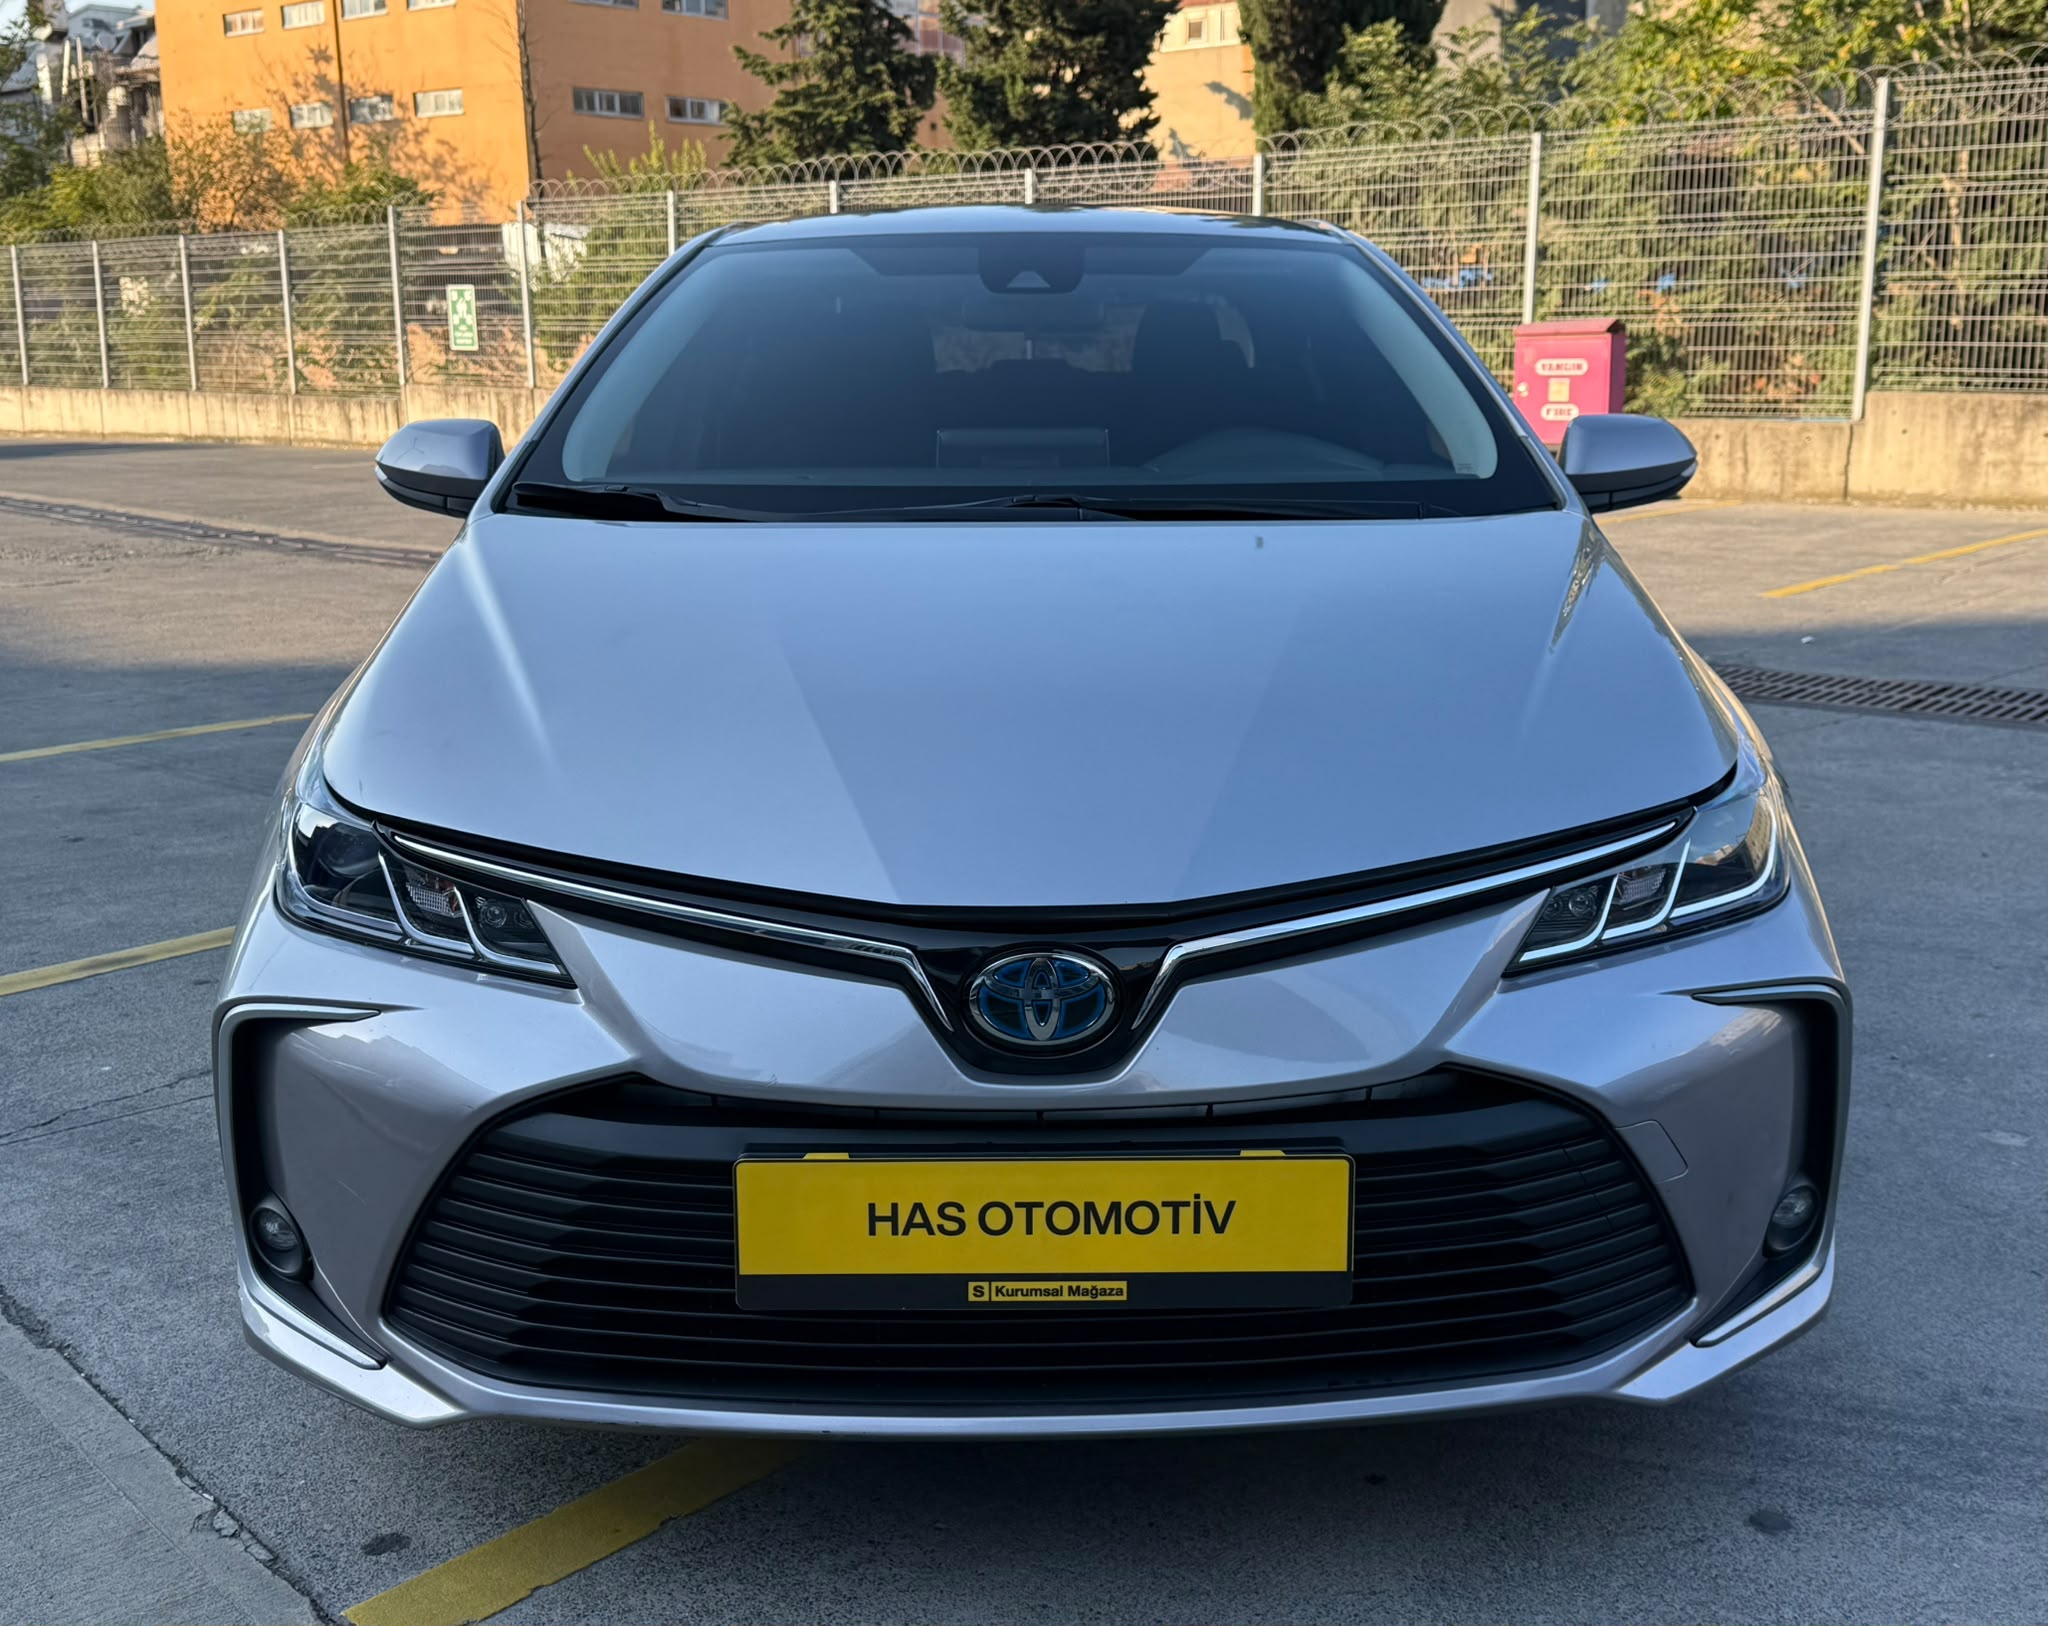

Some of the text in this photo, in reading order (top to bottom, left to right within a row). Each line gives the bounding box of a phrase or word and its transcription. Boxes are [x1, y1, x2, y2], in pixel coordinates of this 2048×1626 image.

[867, 1193, 1237, 1237] HAS OTOMOTİV
[972, 1284, 1124, 1299] S Kurumsal Mağaza
